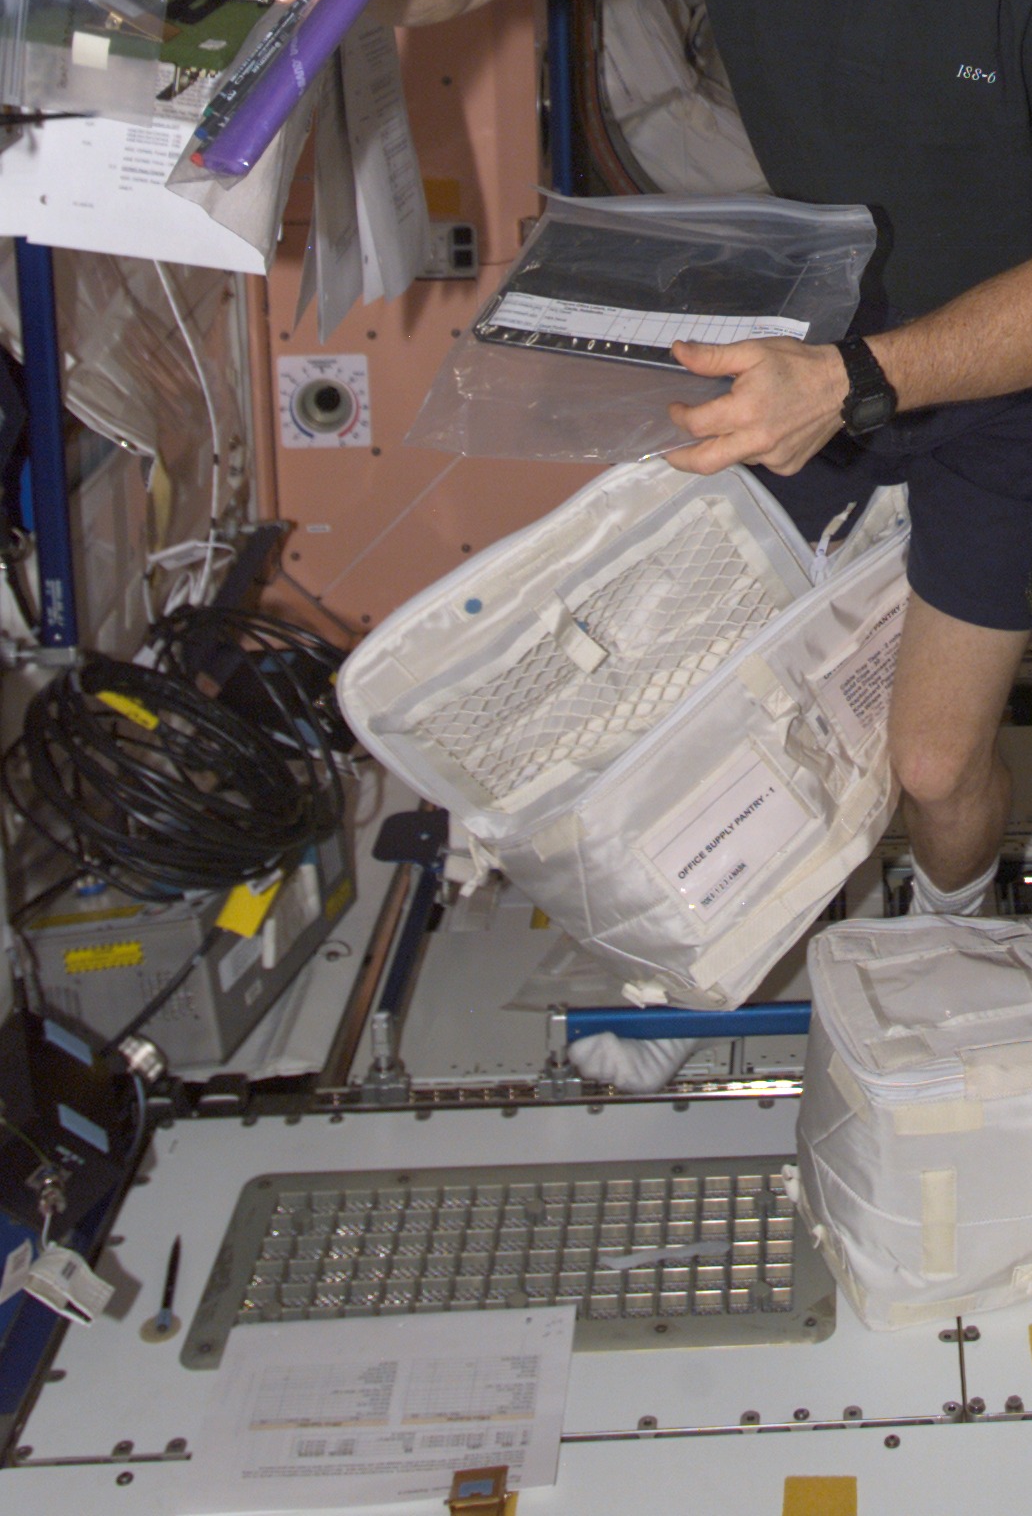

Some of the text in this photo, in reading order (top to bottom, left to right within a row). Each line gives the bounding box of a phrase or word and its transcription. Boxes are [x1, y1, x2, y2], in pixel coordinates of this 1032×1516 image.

[956, 64, 996, 84] ISS-6
[675, 849, 709, 880] OFFICE
[703, 822, 736, 853] SUPPLY
[732, 794, 766, 826] PANTRY
